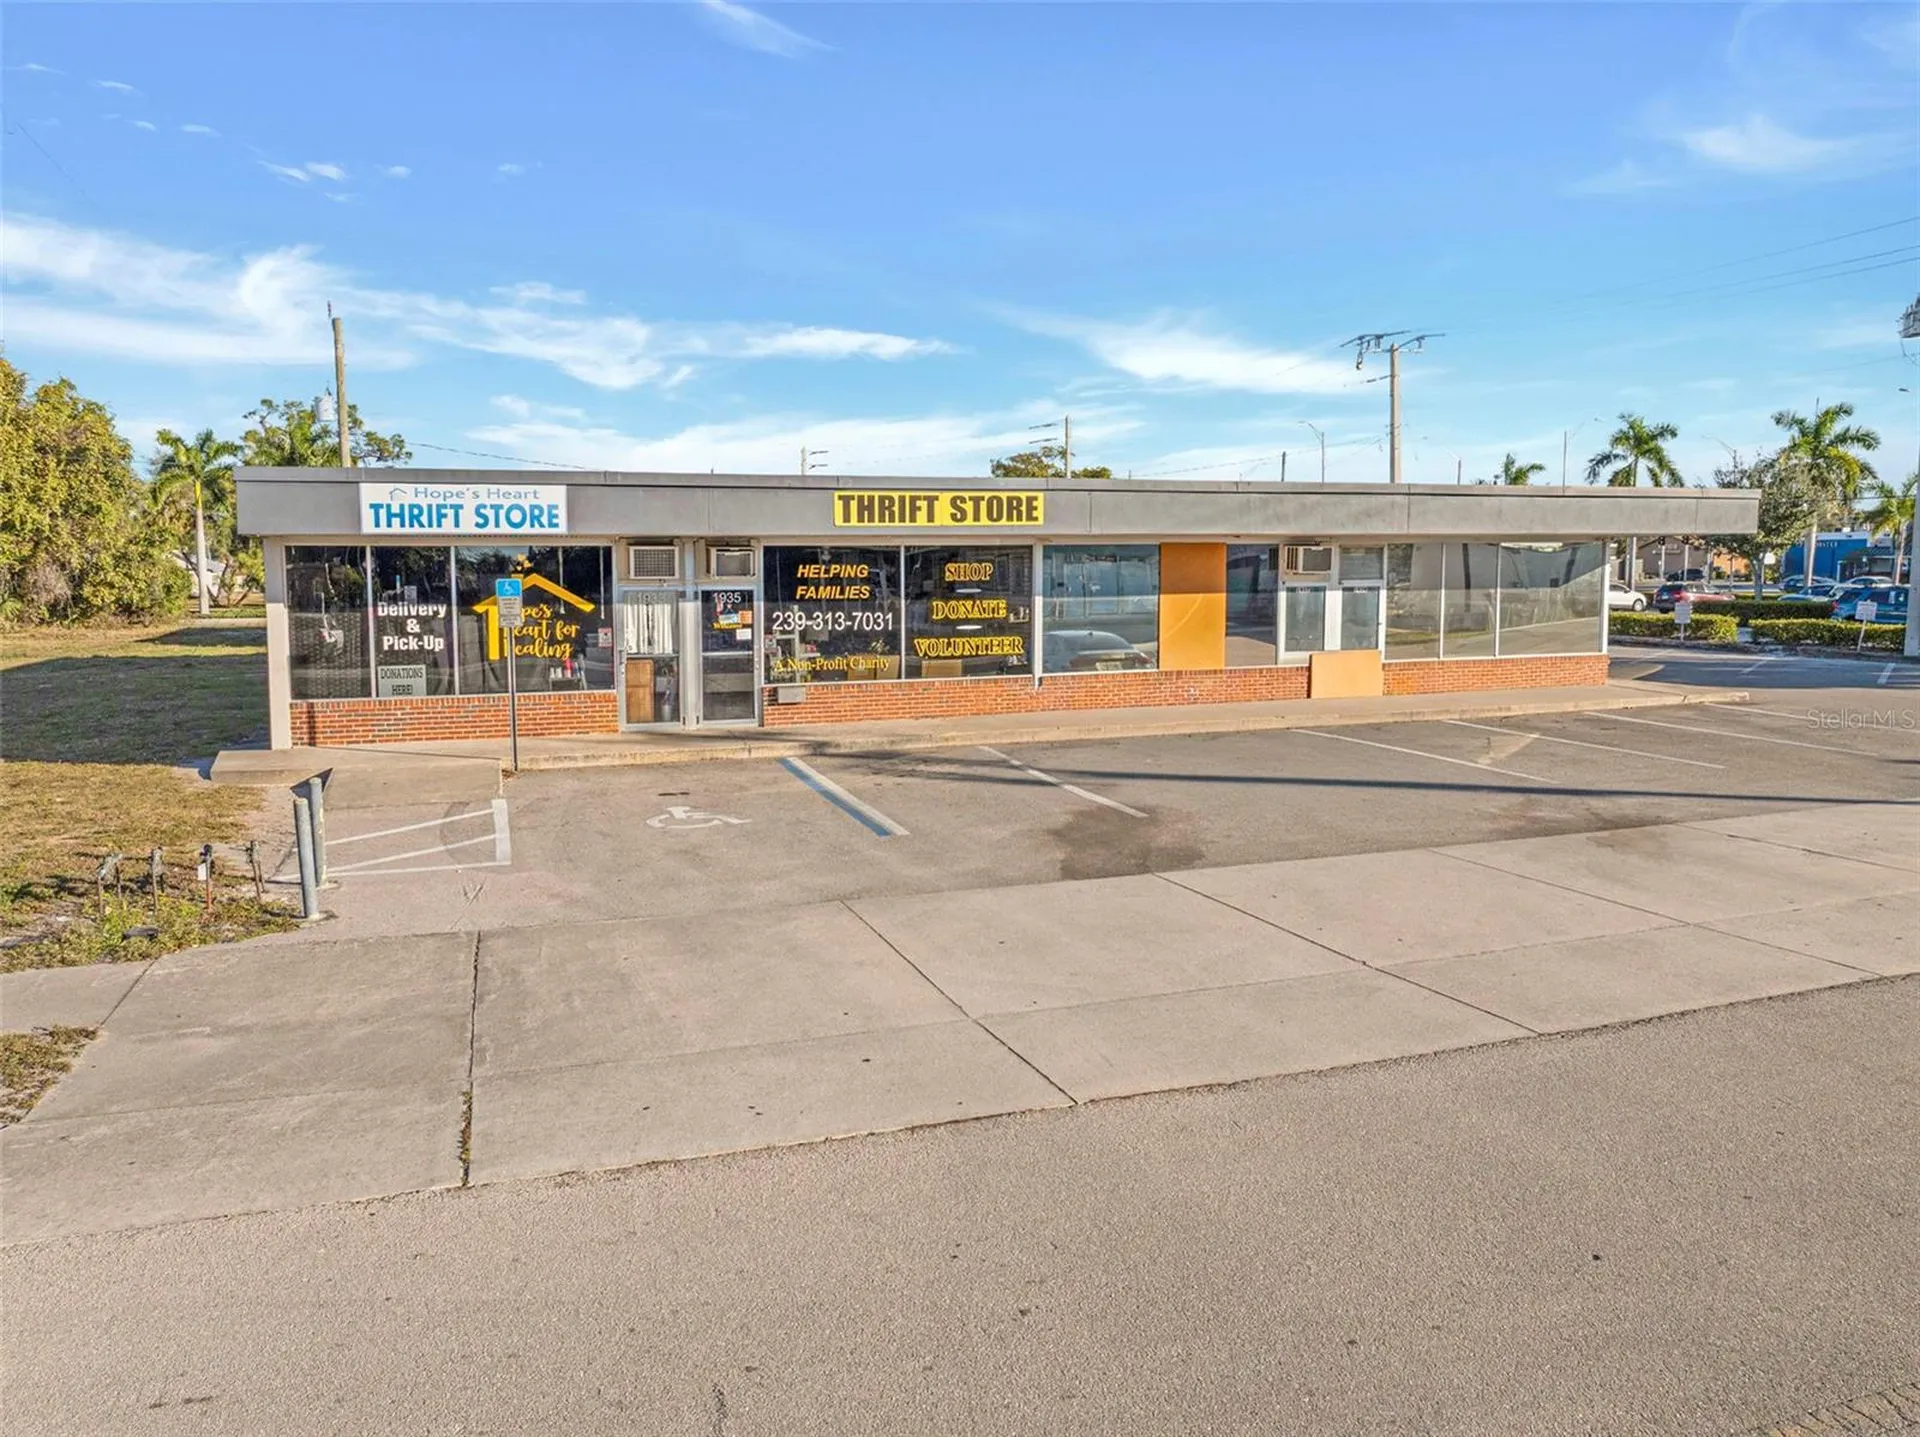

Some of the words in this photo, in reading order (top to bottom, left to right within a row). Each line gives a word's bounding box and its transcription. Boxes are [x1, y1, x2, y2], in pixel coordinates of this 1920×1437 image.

[414, 487, 480, 502] Hope's
[487, 488, 541, 501] Heart
[369, 503, 464, 529] THRIFT
[474, 503, 560, 529] STORE
[838, 494, 939, 524] THRIFT
[950, 494, 1039, 523] STORE
[797, 564, 869, 578] HELPING
[945, 562, 994, 582] SHOP
[712, 591, 741, 604] 1935
[796, 585, 871, 600] FAMILIES
[377, 602, 447, 618] Delivery
[932, 599, 1007, 620] DONATE
[406, 618, 421, 633] &
[772, 611, 893, 631] 239-313-7031
[556, 620, 581, 641] for
[383, 635, 445, 651] Pick-Up
[914, 637, 1025, 657] VOLUNTEER
[775, 660, 784, 672] A
[787, 657, 848, 673] Non-Profit
[850, 656, 890, 671] Charity
[380, 667, 424, 680] DONATIONS
